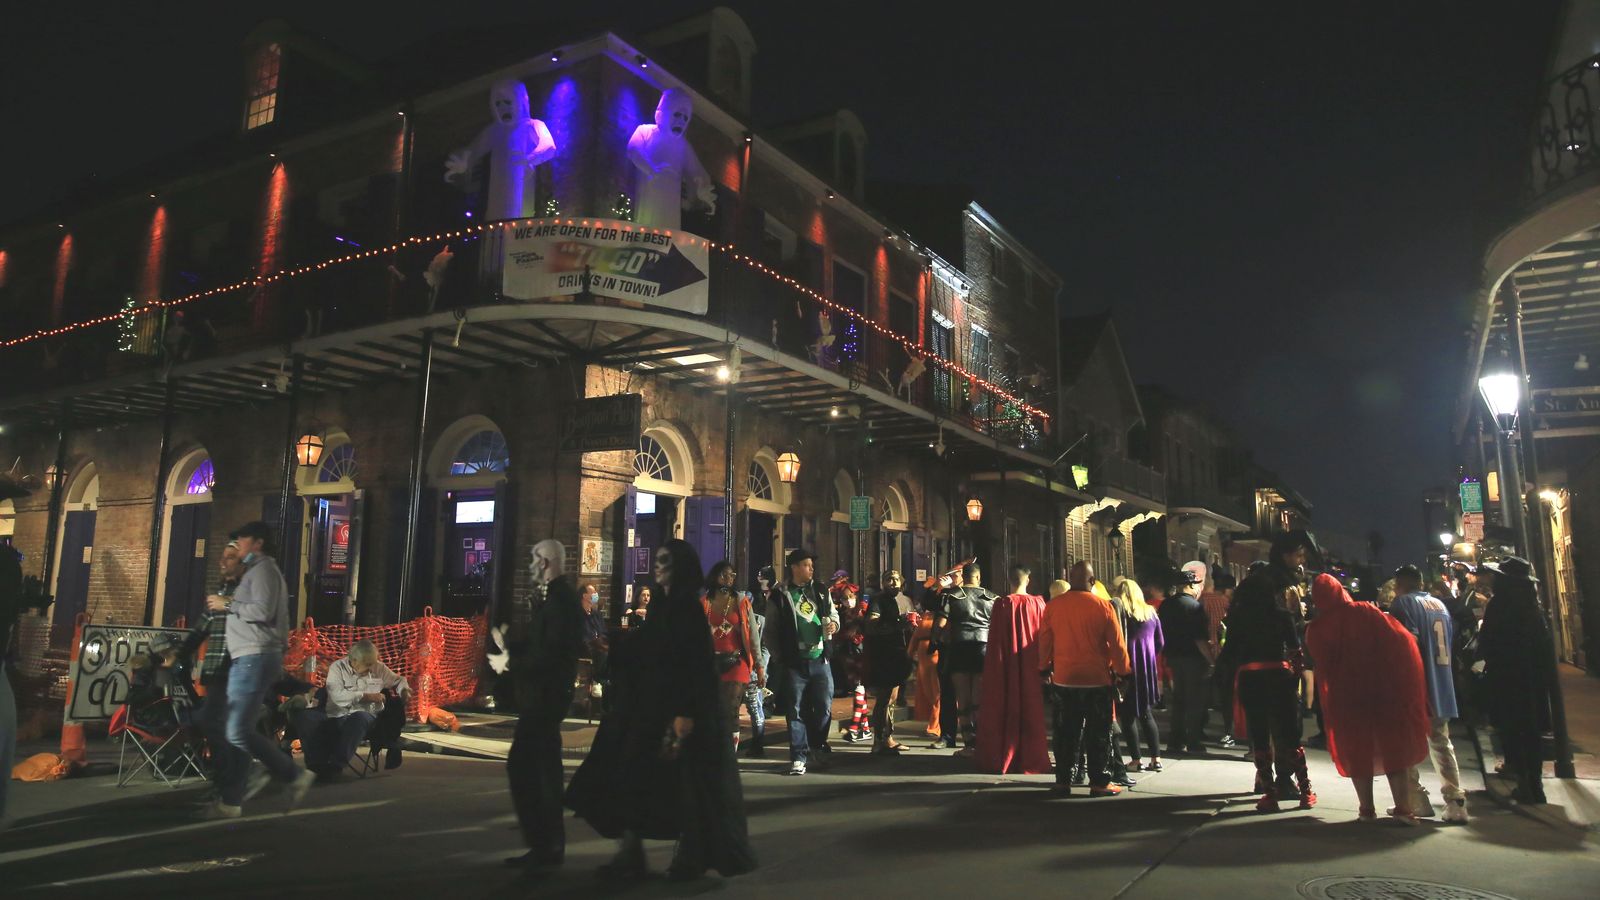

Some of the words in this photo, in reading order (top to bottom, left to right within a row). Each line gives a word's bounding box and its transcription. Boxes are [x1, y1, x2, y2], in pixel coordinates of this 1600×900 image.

[514, 227, 533, 240] WE
[534, 225, 557, 237] ARE
[559, 225, 592, 239] OPEN
[593, 228, 618, 241] FOR
[620, 230, 641, 243] THE
[643, 232, 672, 246] BEST
[602, 277, 617, 290] IN
[619, 280, 657, 298] TOWN!
[1543, 398, 1567, 411] St.
[1433, 620, 1449, 666] 1
